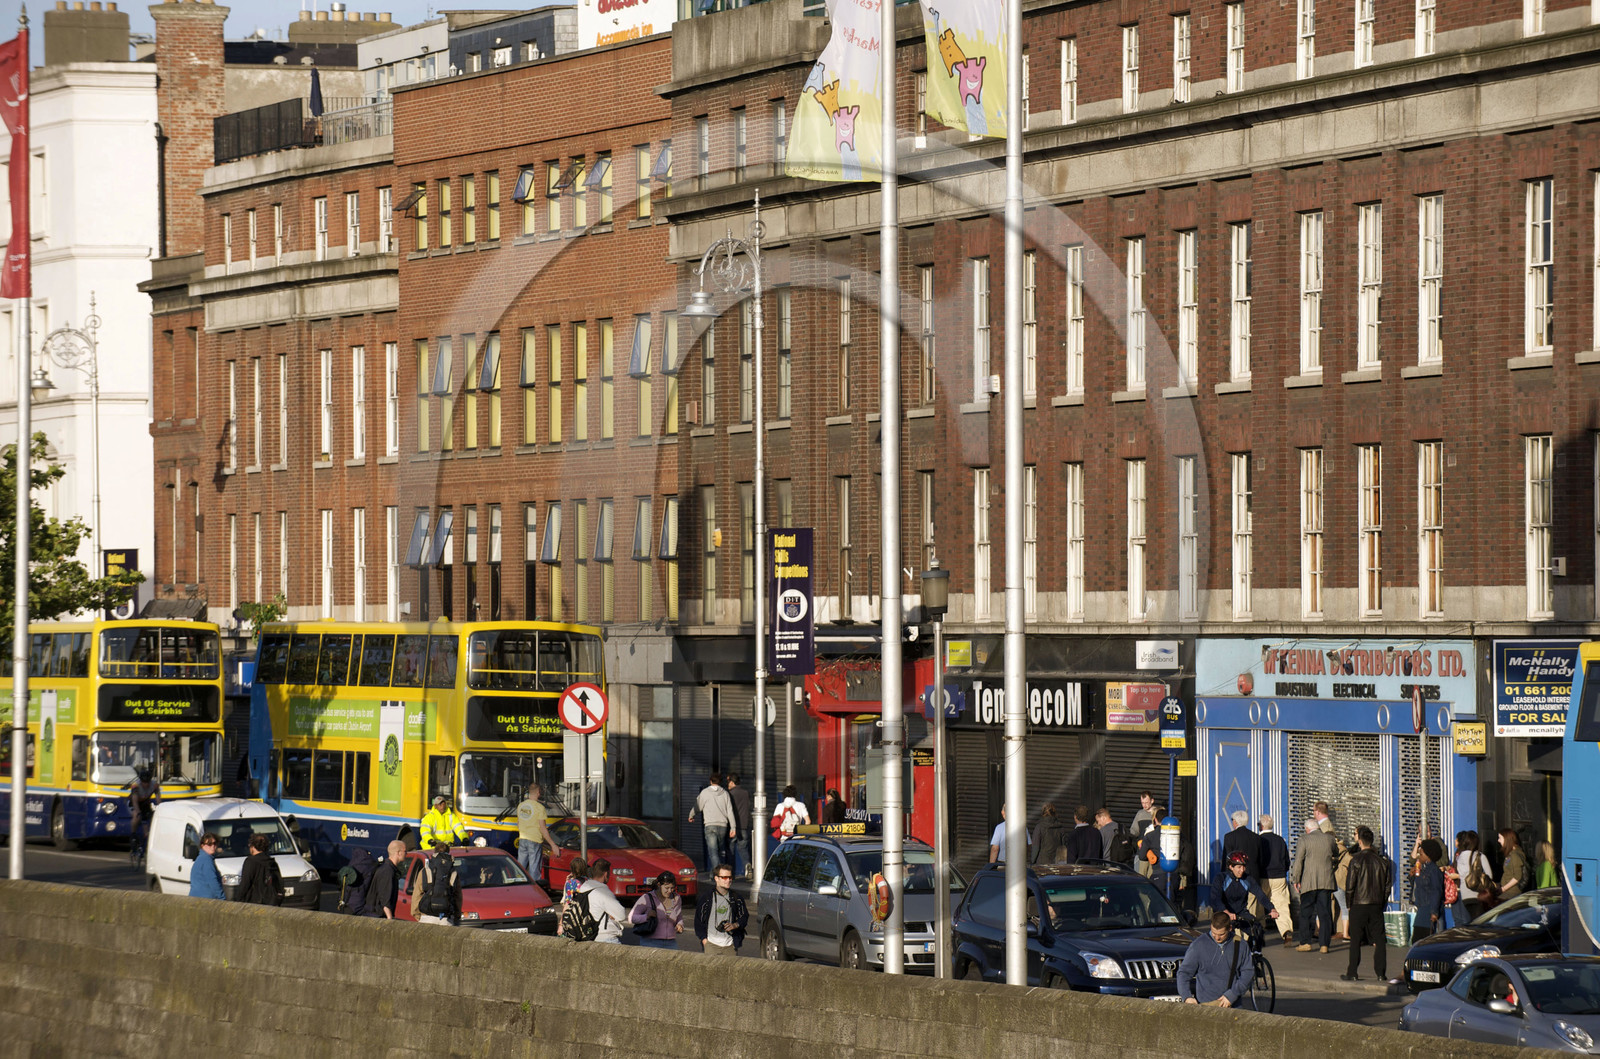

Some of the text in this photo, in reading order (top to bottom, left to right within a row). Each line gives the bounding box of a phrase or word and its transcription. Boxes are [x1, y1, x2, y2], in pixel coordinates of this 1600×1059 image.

[596, 22, 653, 47] Accommodaion
[1330, 649, 1433, 678] DISTRIBUTORS
[1438, 650, 1467, 678] LTD.
[1509, 656, 1570, 668] McNally
[1528, 666, 1575, 677] Handy
[1130, 687, 1138, 695] Top
[1140, 687, 1148, 695] Up
[1275, 682, 1319, 699] INDUSTRIAL
[1333, 683, 1377, 699] ELECTRICAL
[1505, 686, 1572, 695] 01 661 200
[158, 700, 190, 708] Service
[973, 681, 1082, 726] TemecoM
[1513, 696, 1546, 704] LEASEHOLD
[497, 715, 564, 724] Out Of Servi
[1510, 713, 1567, 723] FOR SAL
[506, 724, 519, 732] As
[1529, 727, 1564, 735] mcnallyh
[1456, 737, 1484, 747] RECORDS
[820, 823, 866, 834] TAXI 21804
